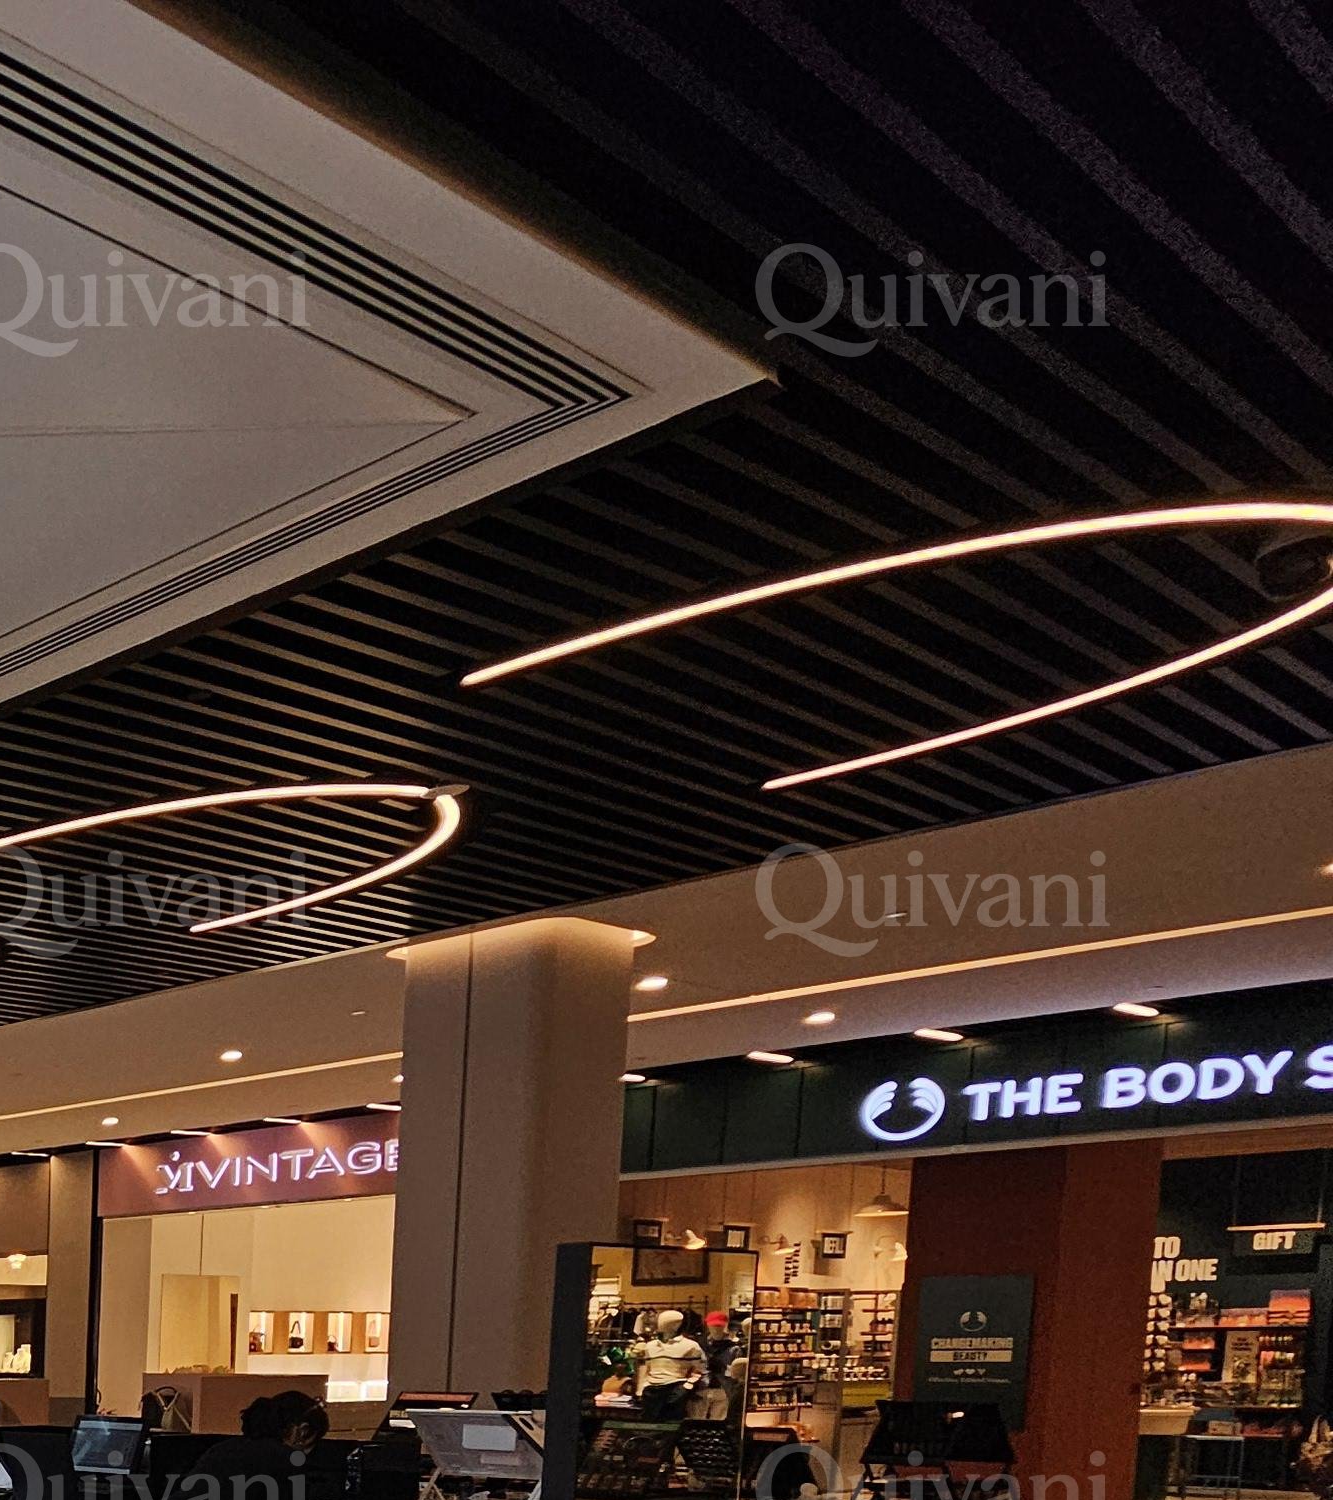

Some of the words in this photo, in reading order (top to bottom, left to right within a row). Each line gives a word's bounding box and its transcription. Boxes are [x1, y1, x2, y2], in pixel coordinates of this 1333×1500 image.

[962, 1073, 1083, 1121] THE
[1101, 1050, 1294, 1108] BODY
[1254, 1231, 1296, 1250] GIFT
[784, 1256, 792, 1284] REFIL
[1175, 1259, 1219, 1282] ONE
